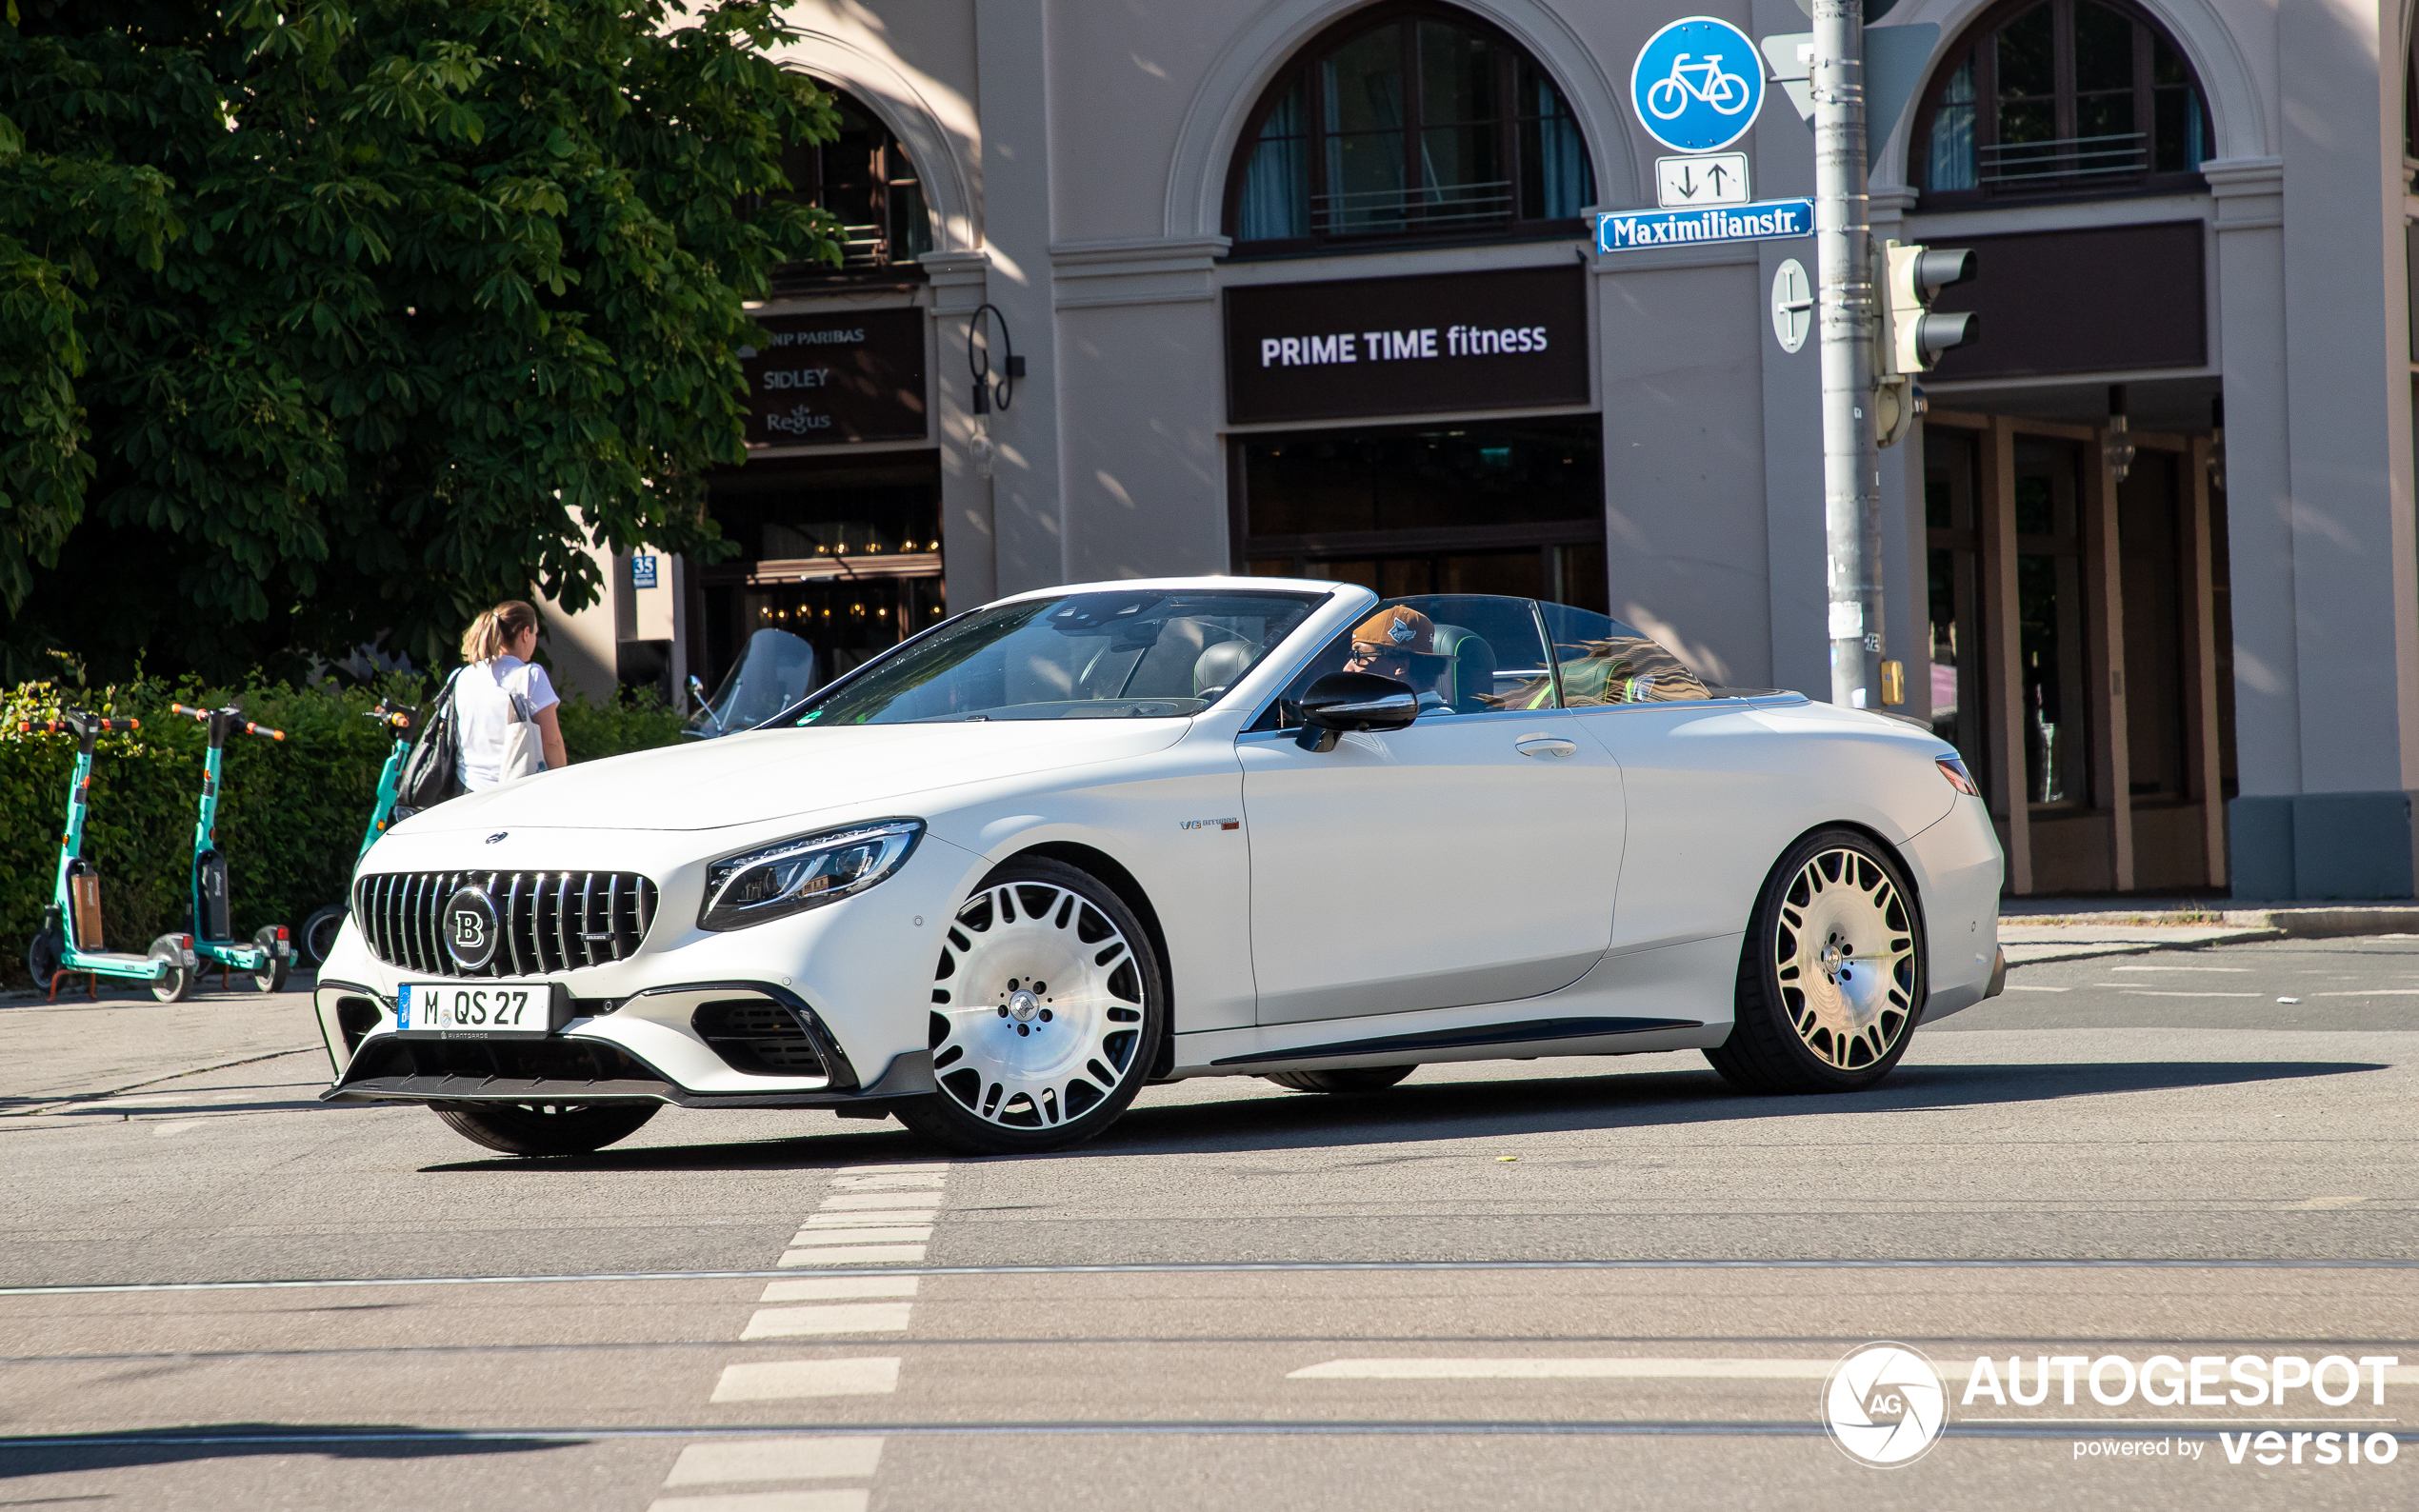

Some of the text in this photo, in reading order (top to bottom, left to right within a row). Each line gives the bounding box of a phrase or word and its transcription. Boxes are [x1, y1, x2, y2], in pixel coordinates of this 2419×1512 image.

[1613, 208, 1801, 247] Maximilianstr.
[770, 328, 866, 347] NP PARIBAS
[1261, 325, 1548, 368] PRIME TIME fitness
[763, 368, 830, 390] SIDLEY
[767, 412, 831, 435] Regus
[634, 557, 654, 574] 35
[455, 911, 484, 947] B
[424, 990, 529, 1025] M QS 27
